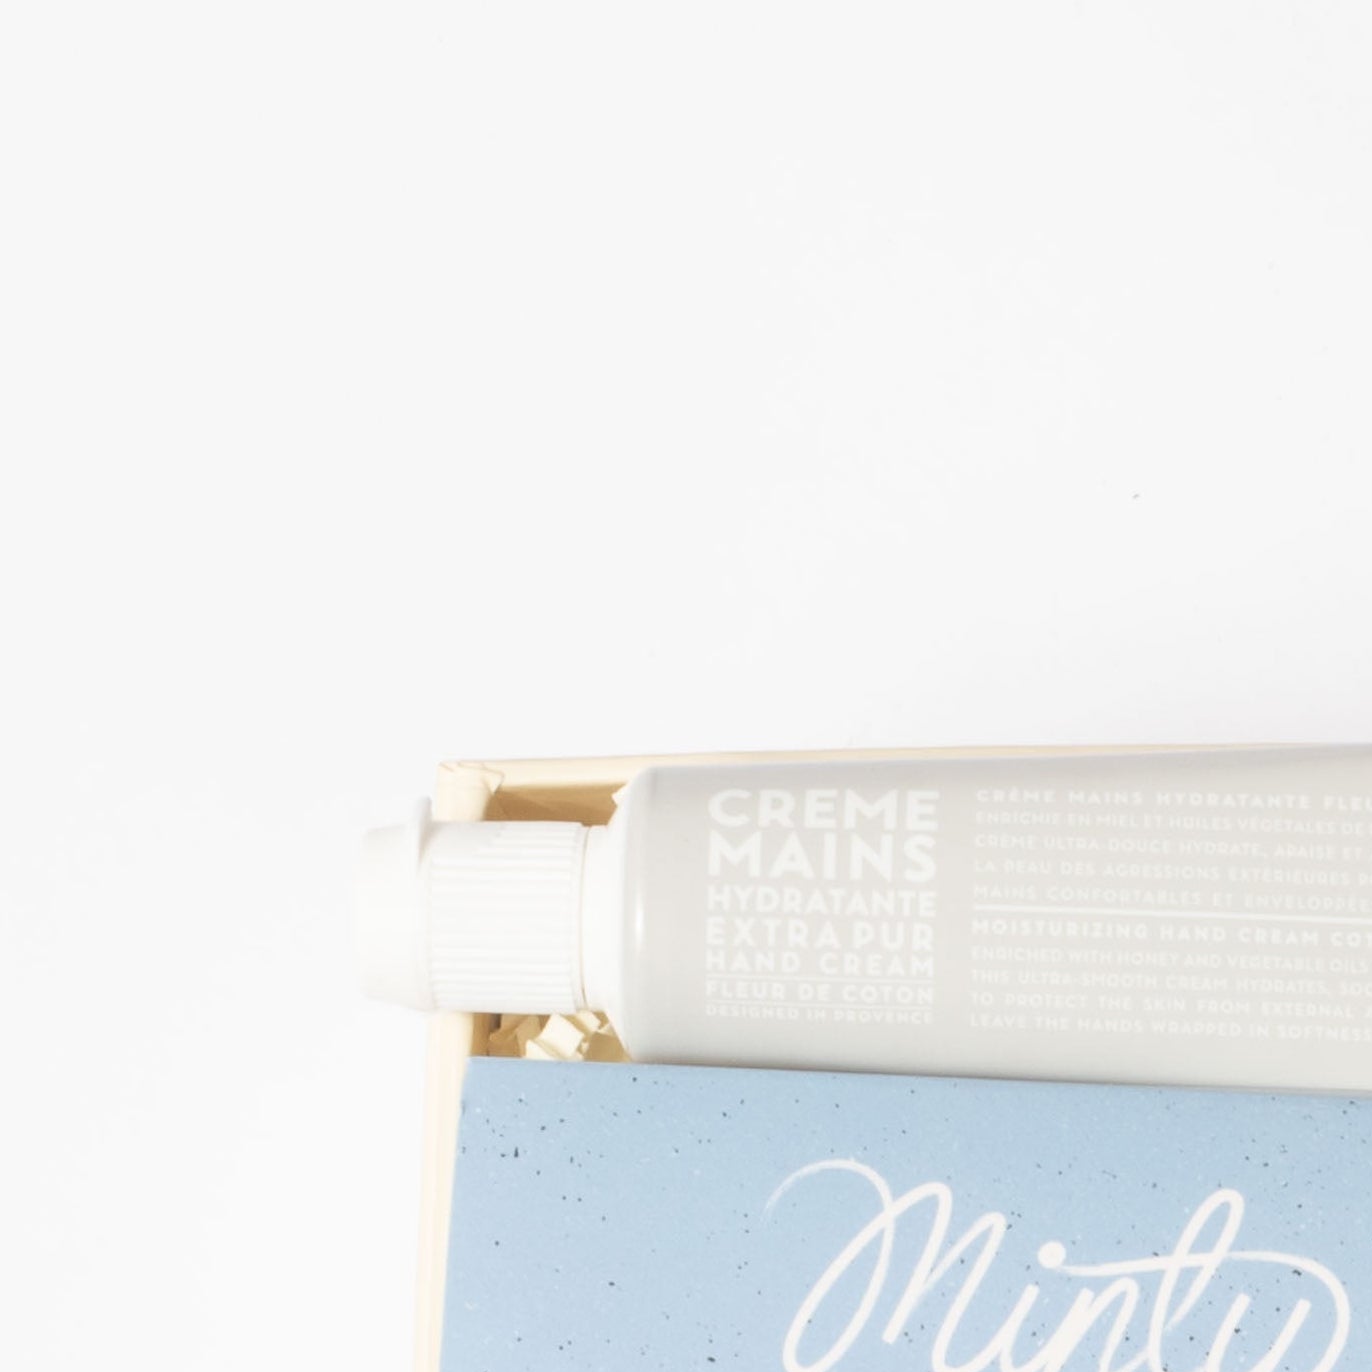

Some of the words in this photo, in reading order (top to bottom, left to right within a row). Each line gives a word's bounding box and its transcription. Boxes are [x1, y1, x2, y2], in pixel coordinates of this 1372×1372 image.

[708, 789, 940, 831] CREME
[1068, 791, 1142, 804] MAINS
[1157, 791, 1311, 810] HYDRATANTE
[708, 830, 936, 882] MAINS
[1060, 861, 1095, 875] DES
[706, 885, 936, 917] HYDRATANTE
[706, 916, 840, 948] EXTRA
[853, 921, 933, 951] PUR
[972, 919, 1148, 939] MOISTURIZING
[1160, 924, 1226, 941] HAND
[1238, 928, 1318, 946] CREAM
[706, 949, 800, 972] HAND
[819, 953, 933, 977] CREAM
[706, 981, 785, 999] FLEUR
[799, 984, 830, 1001] DE
[842, 985, 933, 1004] COTON
[706, 1005, 799, 1019] DESIGNED
[807, 1010, 825, 1019] IN
[834, 1010, 932, 1024] PROVENCE
